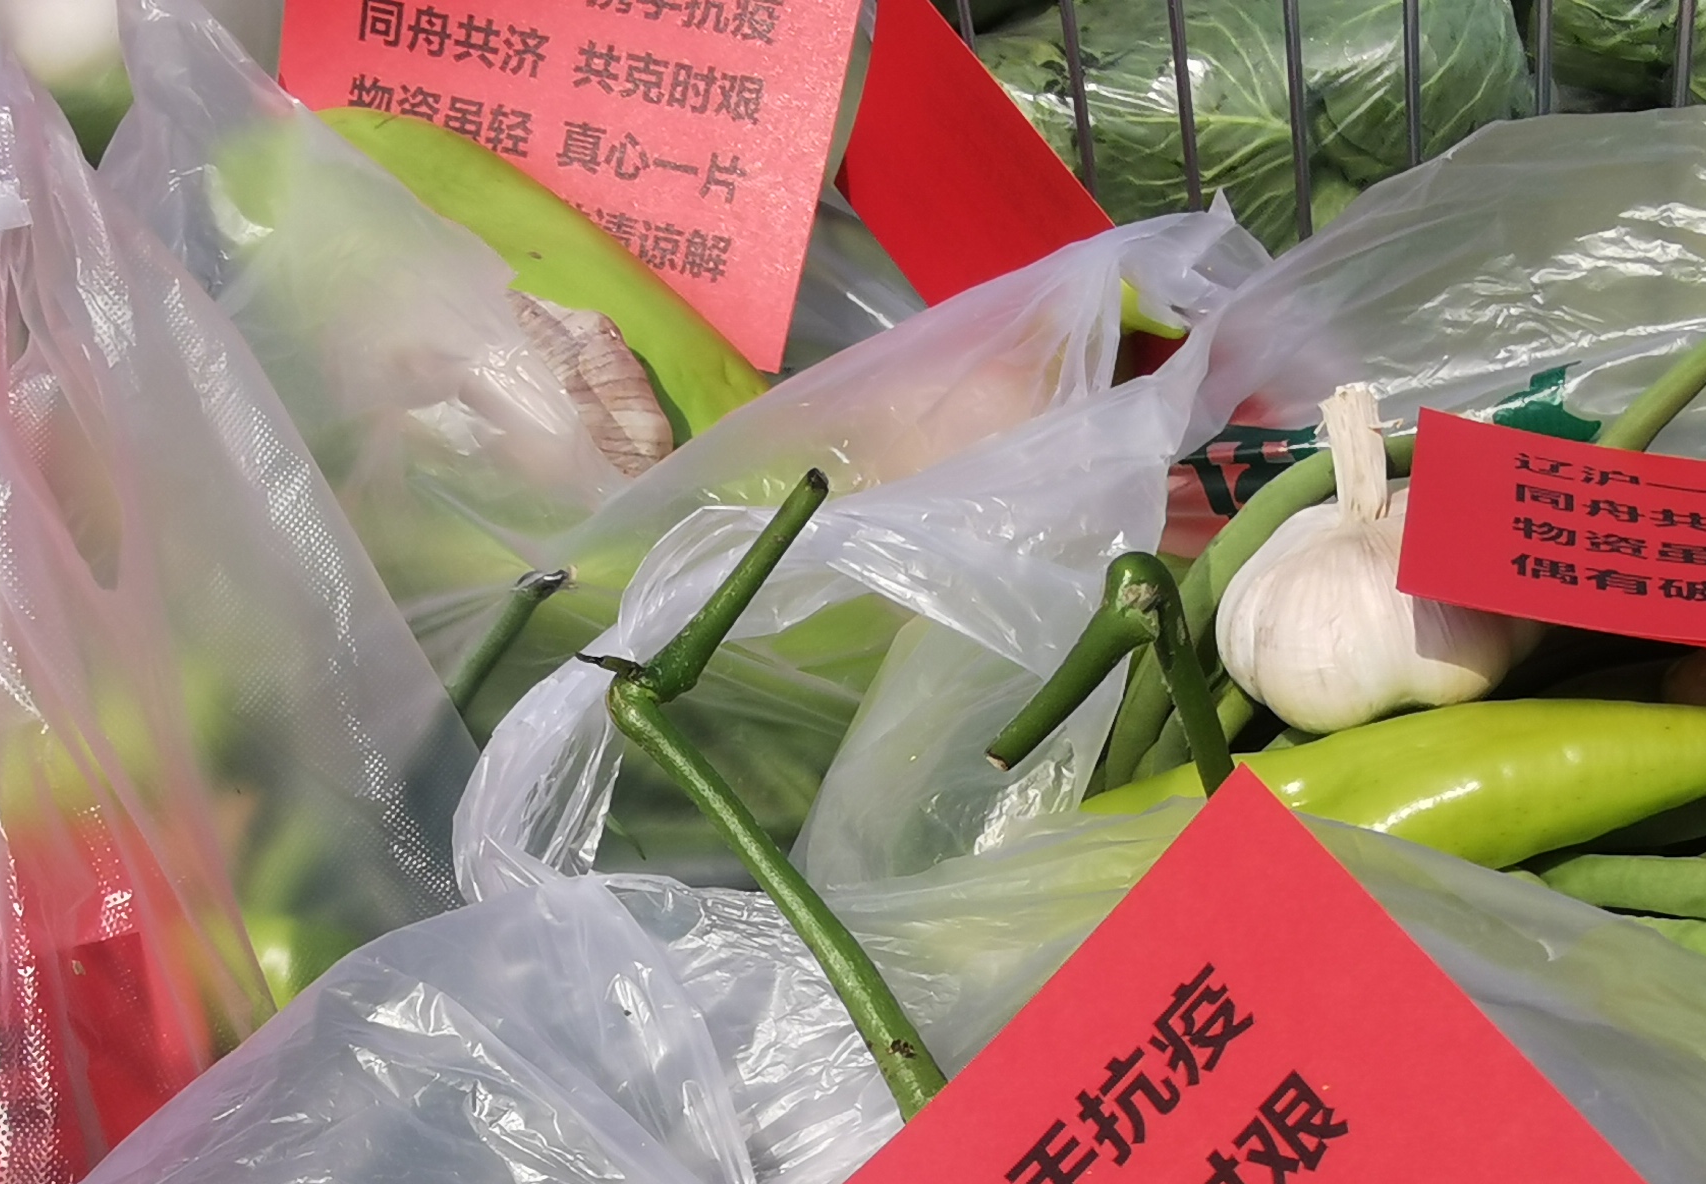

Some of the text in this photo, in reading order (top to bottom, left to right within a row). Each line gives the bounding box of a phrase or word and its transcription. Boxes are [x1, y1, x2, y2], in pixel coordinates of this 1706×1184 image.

[359, 0, 764, 125] 同舟共济 共克时艰
[556, 122, 749, 203] 真心一片
[566, 200, 733, 284] 请谅解
